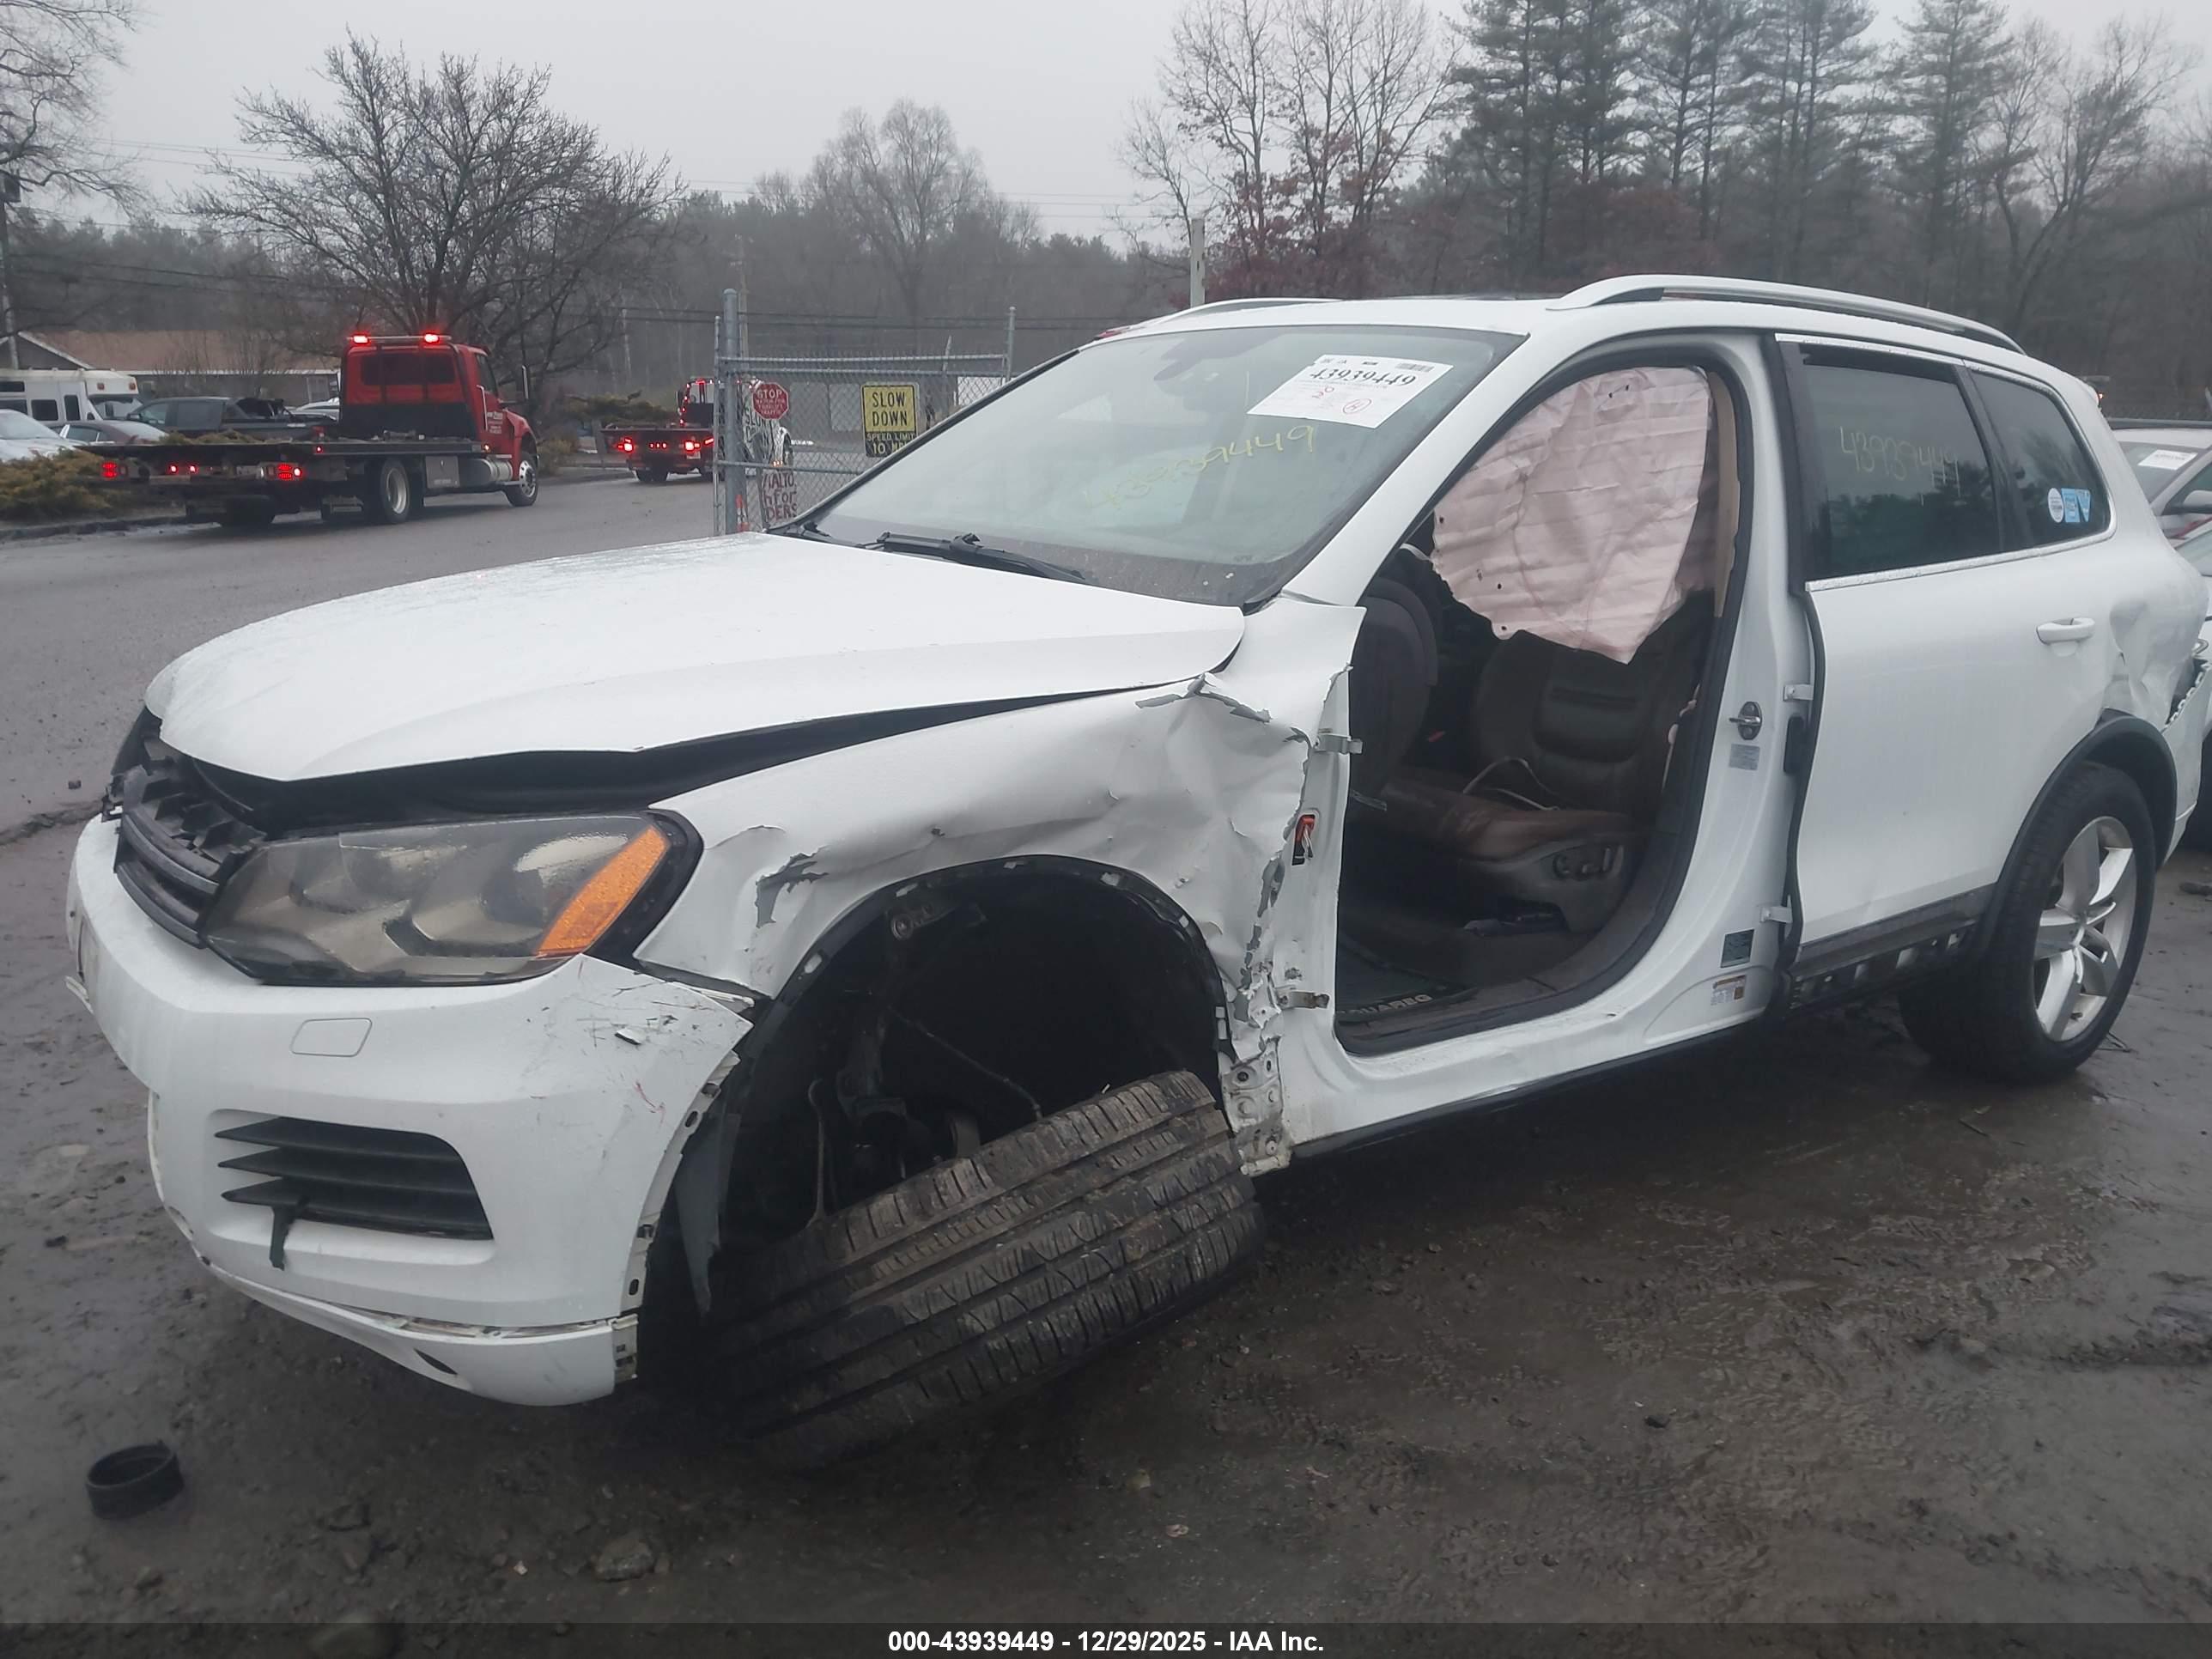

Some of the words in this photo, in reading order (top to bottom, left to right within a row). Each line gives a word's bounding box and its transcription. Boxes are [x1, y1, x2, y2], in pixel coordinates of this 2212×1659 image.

[1310, 368, 1417, 386] 43939449
[757, 389, 782, 399] STOP
[872, 392, 905, 408] SLOW
[872, 410, 908, 427] DOWN
[872, 441, 886, 454] 10
[892, 441, 907, 453] MP
